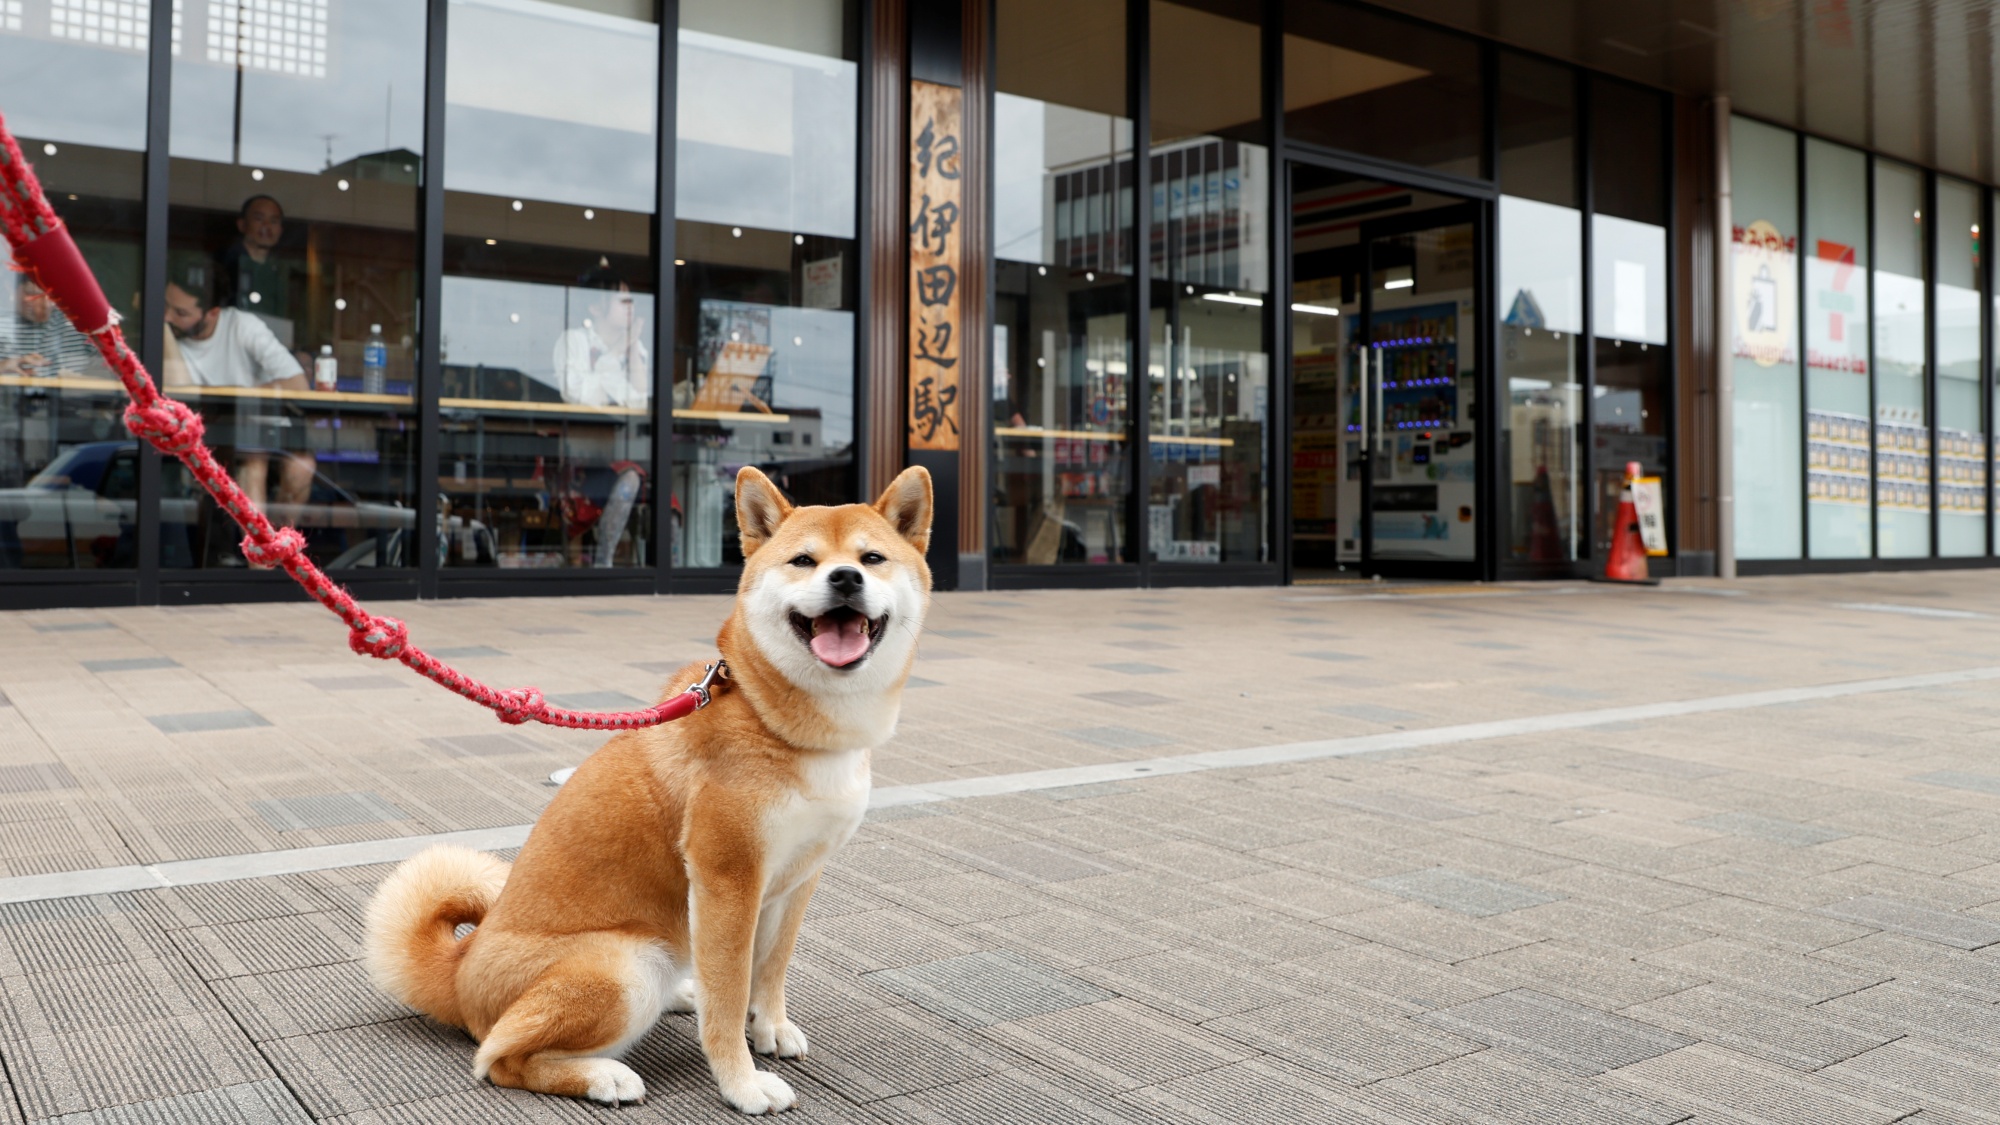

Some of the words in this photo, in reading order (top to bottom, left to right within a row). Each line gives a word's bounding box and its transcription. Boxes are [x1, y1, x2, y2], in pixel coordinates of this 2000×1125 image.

[909, 117, 961, 442] 紀伊田辺駅
